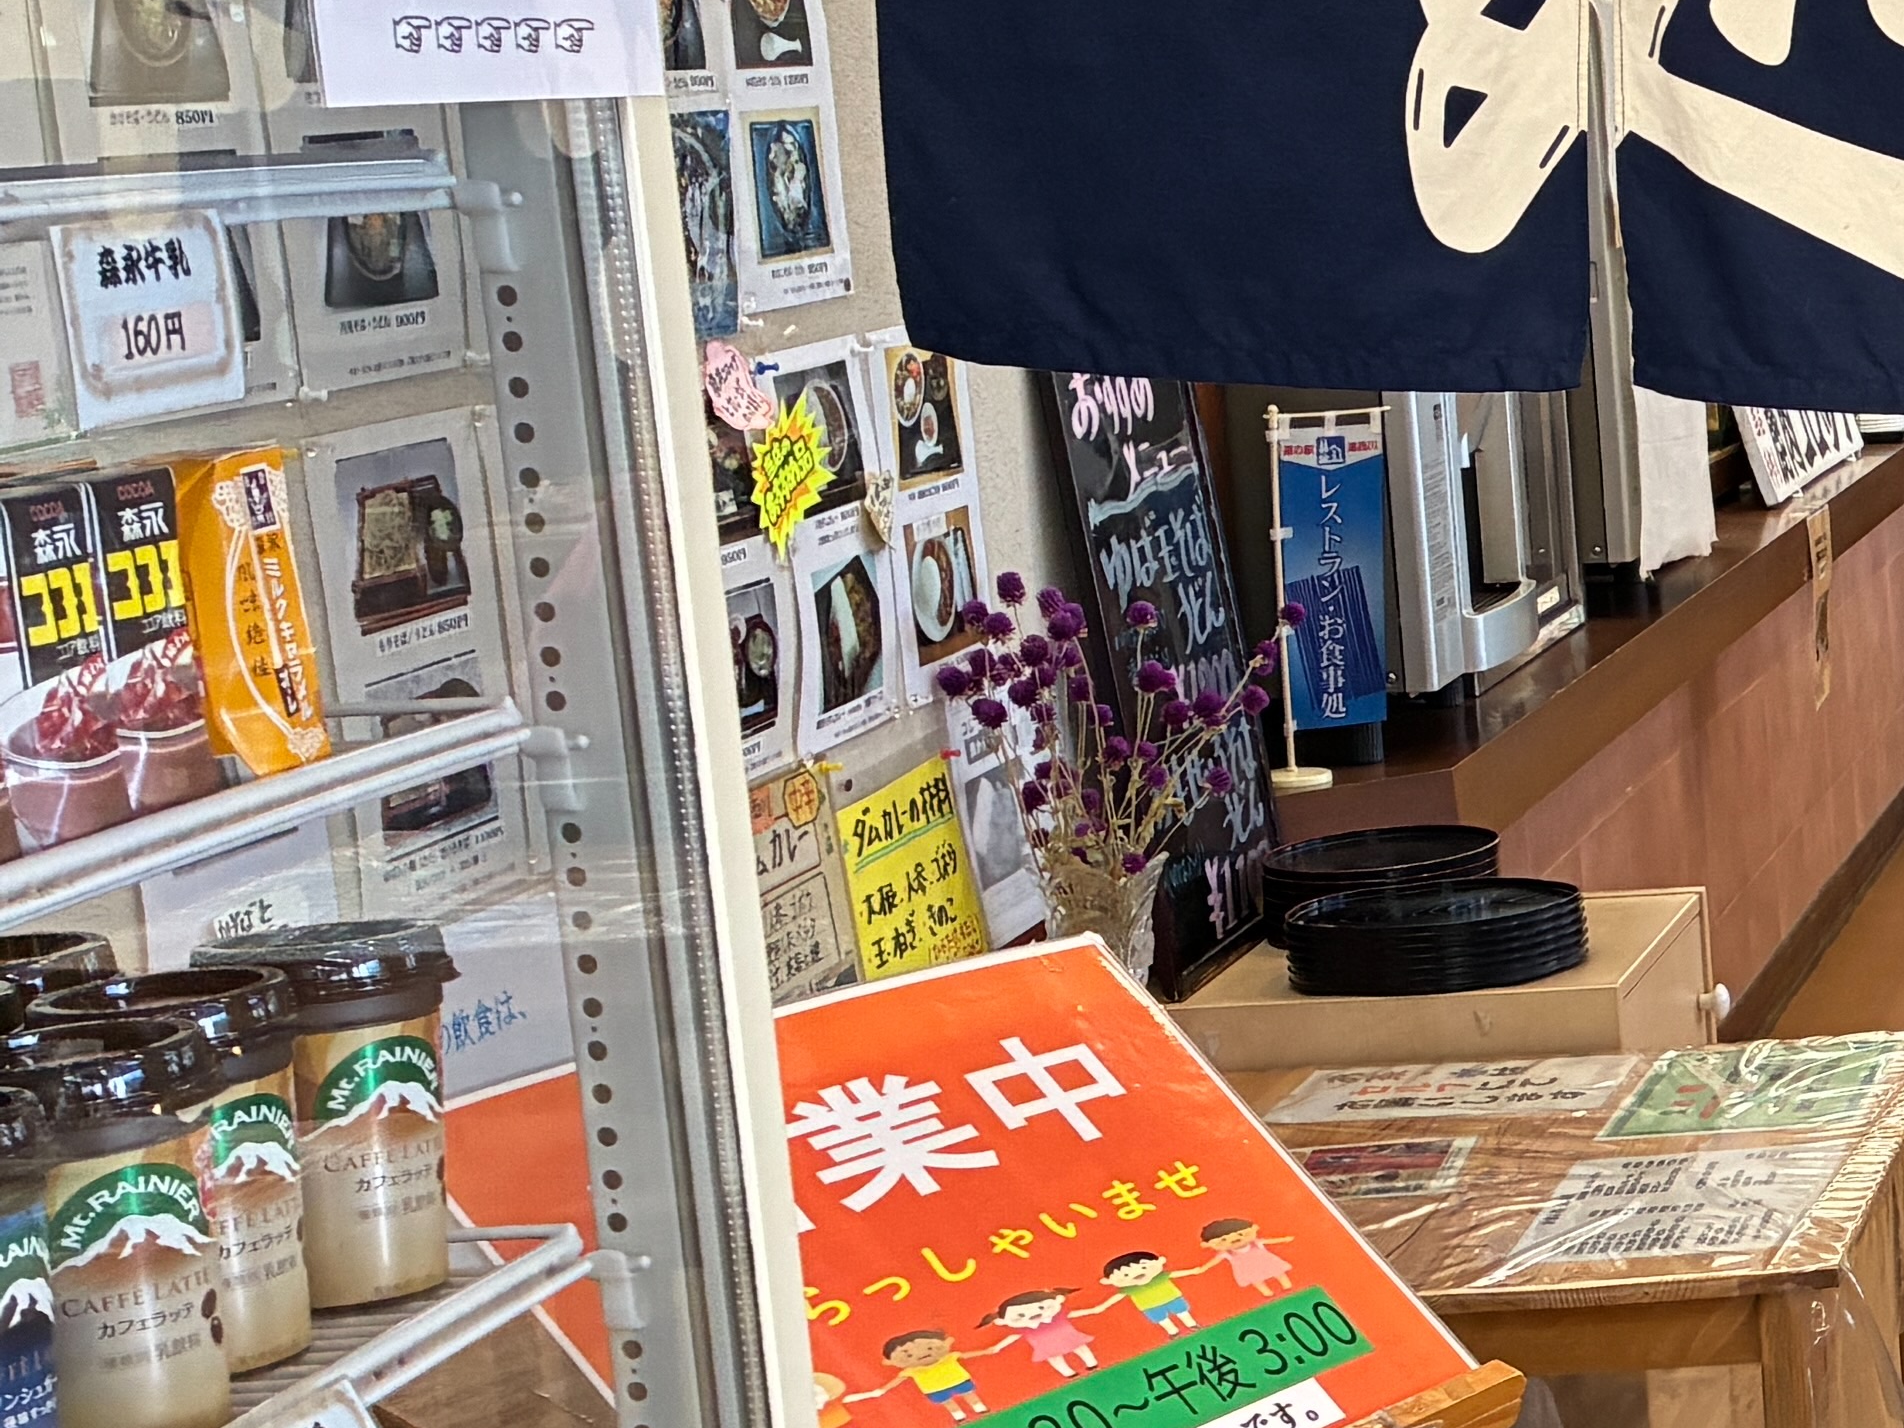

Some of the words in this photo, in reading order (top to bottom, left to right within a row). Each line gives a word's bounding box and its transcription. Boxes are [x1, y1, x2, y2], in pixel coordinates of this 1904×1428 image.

[97, 237, 192, 289] 森永牛乳
[122, 311, 186, 361] 160円
[30, 523, 82, 565] 森永
[117, 501, 169, 542] 森永
[1318, 474, 1347, 719] レストラン・お食事処
[787, 1036, 1127, 1235] 業中
[805, 1160, 1209, 1328] らっしゃいませ
[97, 1301, 194, 1340] カフェラッテ
